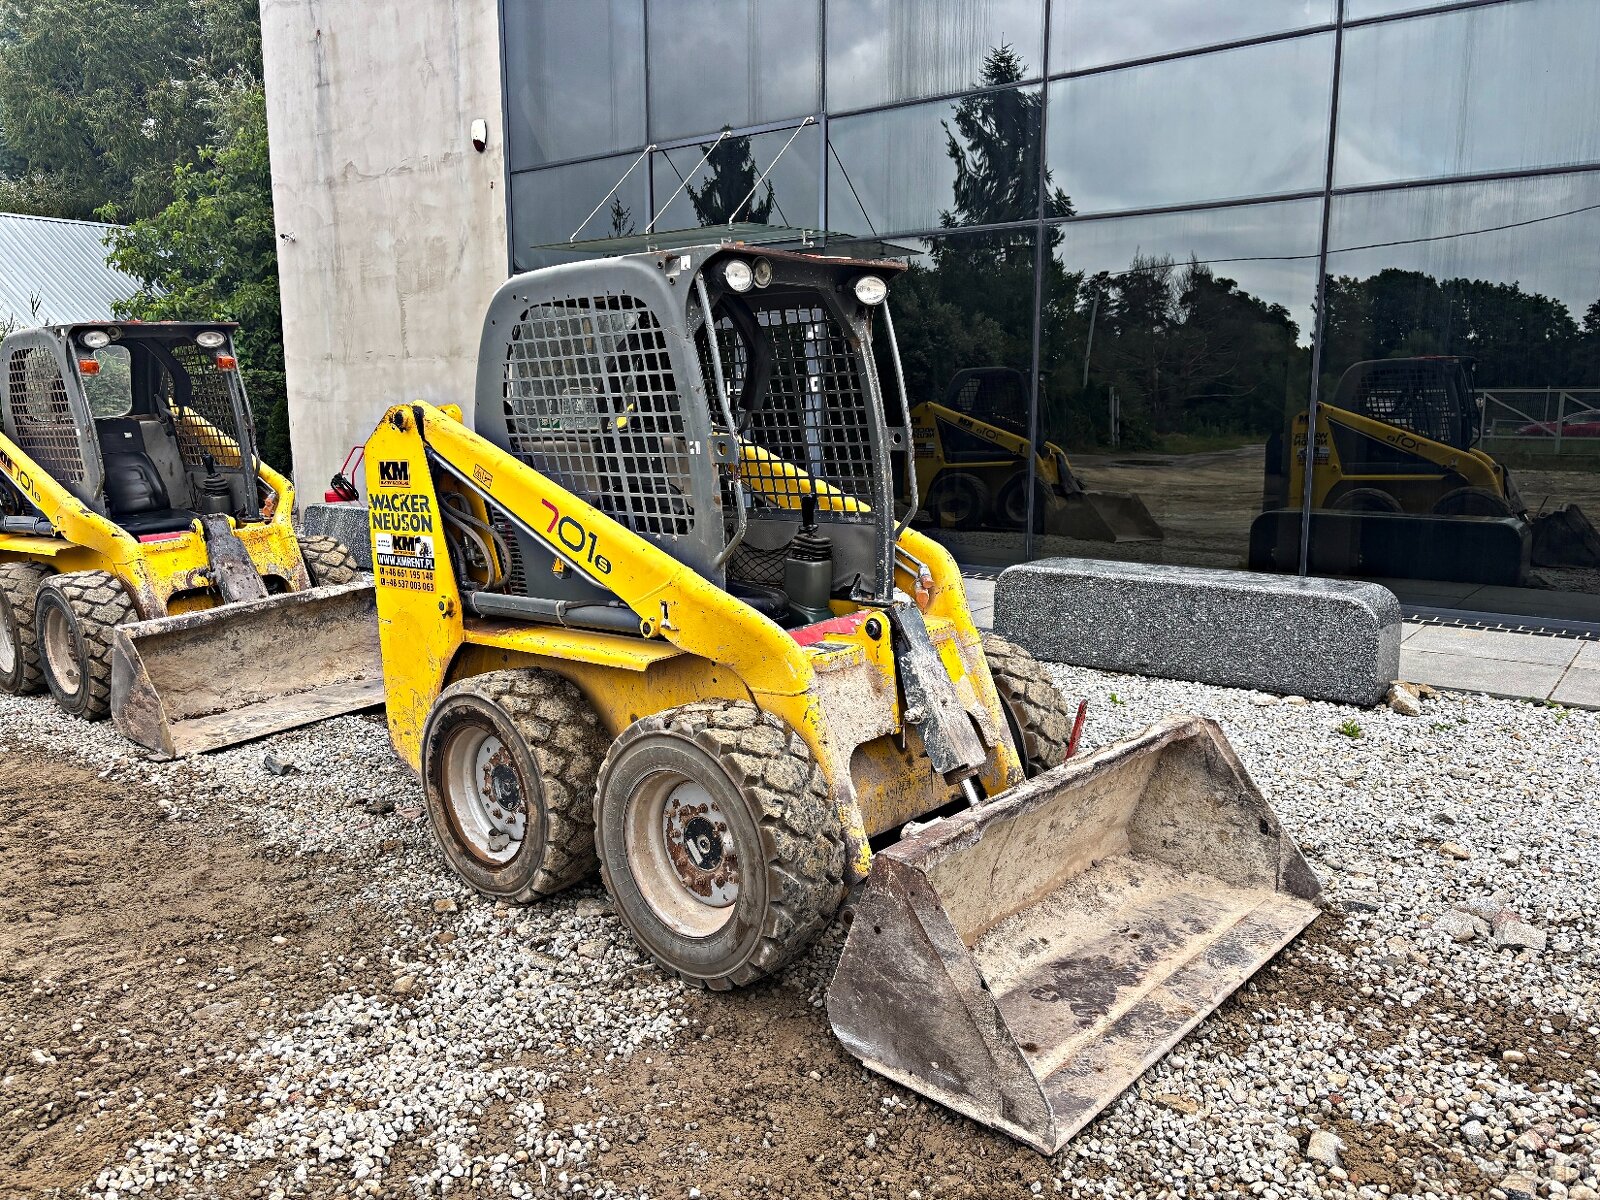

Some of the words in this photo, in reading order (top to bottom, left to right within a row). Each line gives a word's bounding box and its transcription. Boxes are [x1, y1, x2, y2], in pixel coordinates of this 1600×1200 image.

[379, 461, 409, 480] KM
[369, 494, 431, 513] WACKER
[372, 512, 433, 532] NEUSON
[392, 535, 415, 551] KM
[378, 554, 434, 569] WWW.KMRENT.PL
[386, 568, 396, 577] +48
[397, 569, 408, 577] 661
[410, 570, 421, 579] 195
[422, 572, 433, 580] 148
[387, 578, 397, 587] +48
[398, 579, 408, 588] 537
[410, 581, 421, 590] 003
[423, 582, 434, 592] 063
